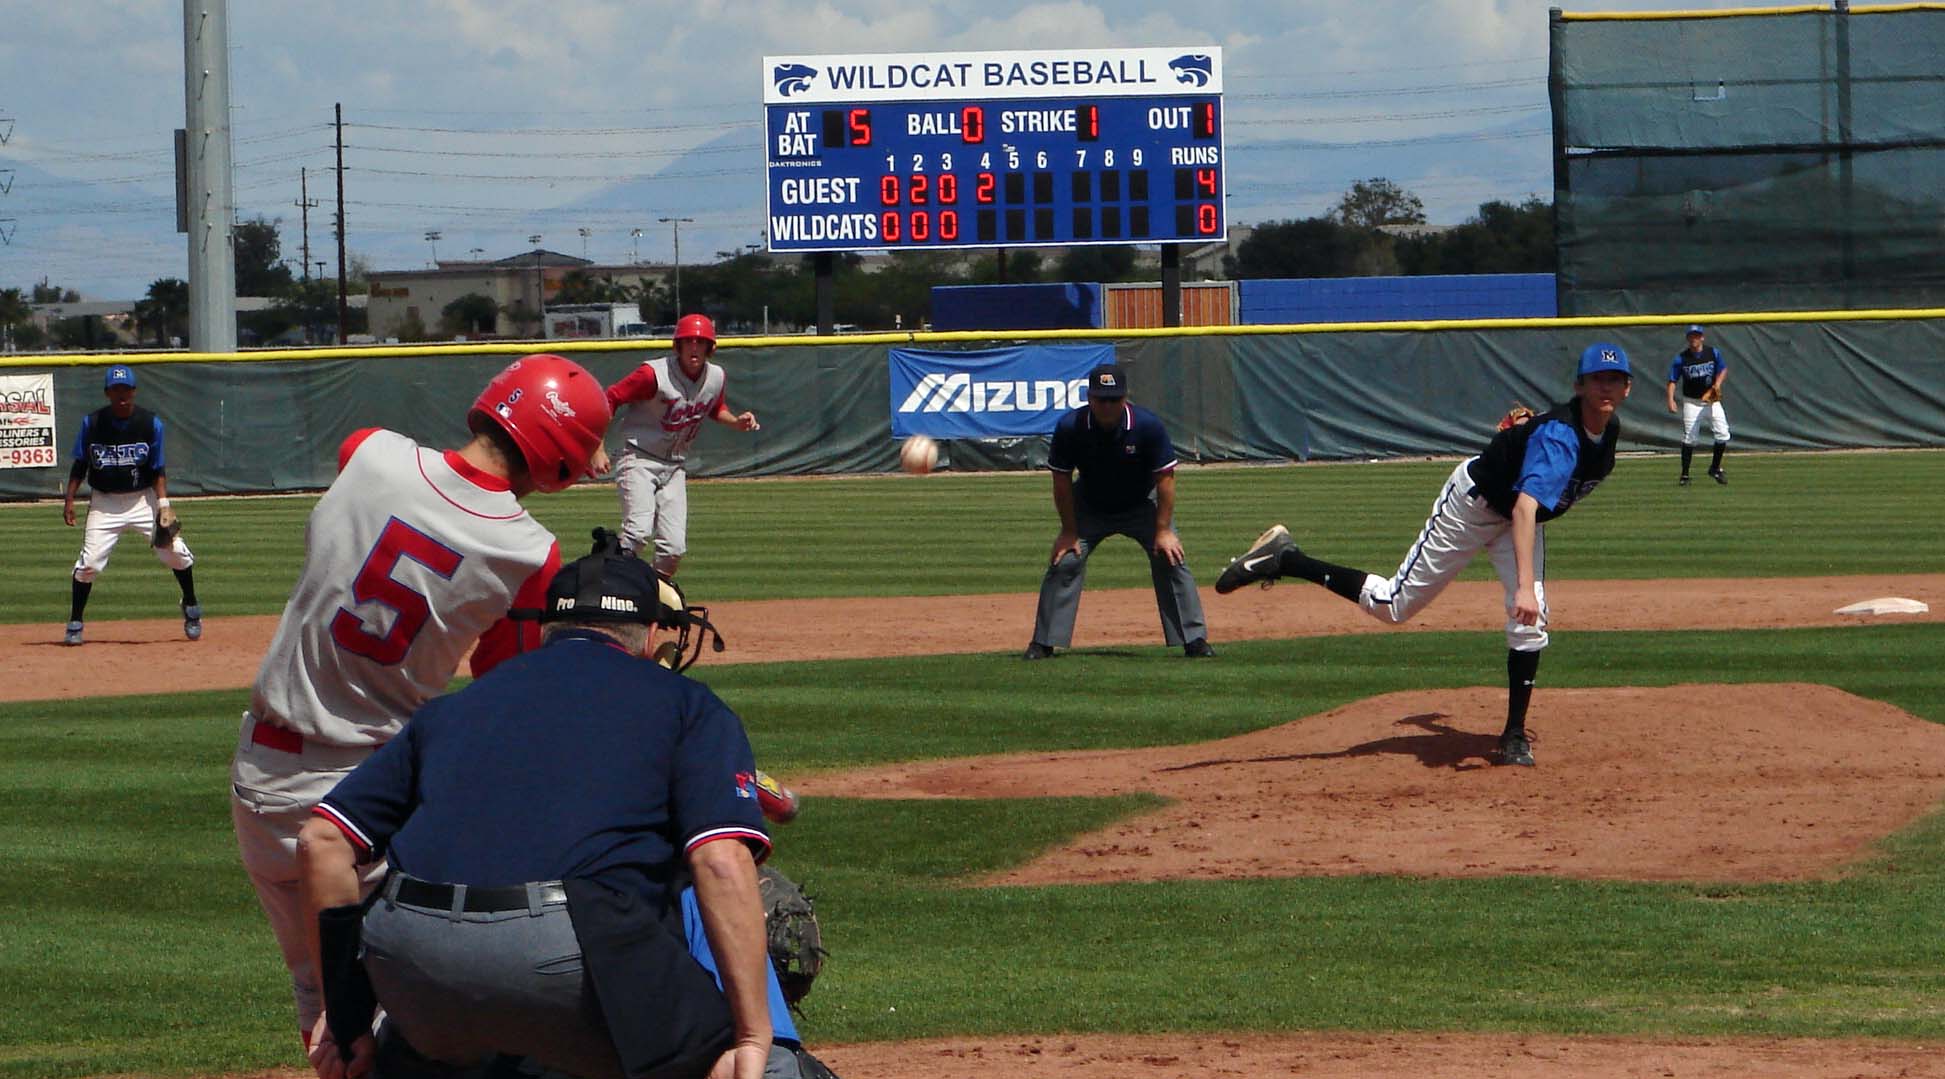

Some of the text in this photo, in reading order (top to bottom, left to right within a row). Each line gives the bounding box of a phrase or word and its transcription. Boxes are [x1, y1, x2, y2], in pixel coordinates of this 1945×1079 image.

[827, 59, 1157, 90] WILDCAT BASEBALL
[785, 112, 811, 133] AT
[849, 108, 872, 146] 5
[907, 112, 962, 136] BALL
[962, 105, 984, 143] 0
[1001, 109, 1077, 133] STRIKE
[1148, 107, 1192, 130] OUT
[778, 134, 817, 156] BAT
[769, 160, 822, 168] DAKTRONICS
[886, 146, 1219, 172] 1 2 3 4 5 6 7 8 9 RUNS
[781, 177, 861, 205] GUEST
[881, 168, 1216, 205] 0 2 0 2 4
[772, 213, 877, 241] WILDCATS
[881, 203, 1218, 242] 0 0 0 0
[1601, 350, 1619, 363] M
[898, 373, 1090, 413] MIZUNO
[330, 515, 465, 667] 5
[556, 597, 576, 612] Pro
